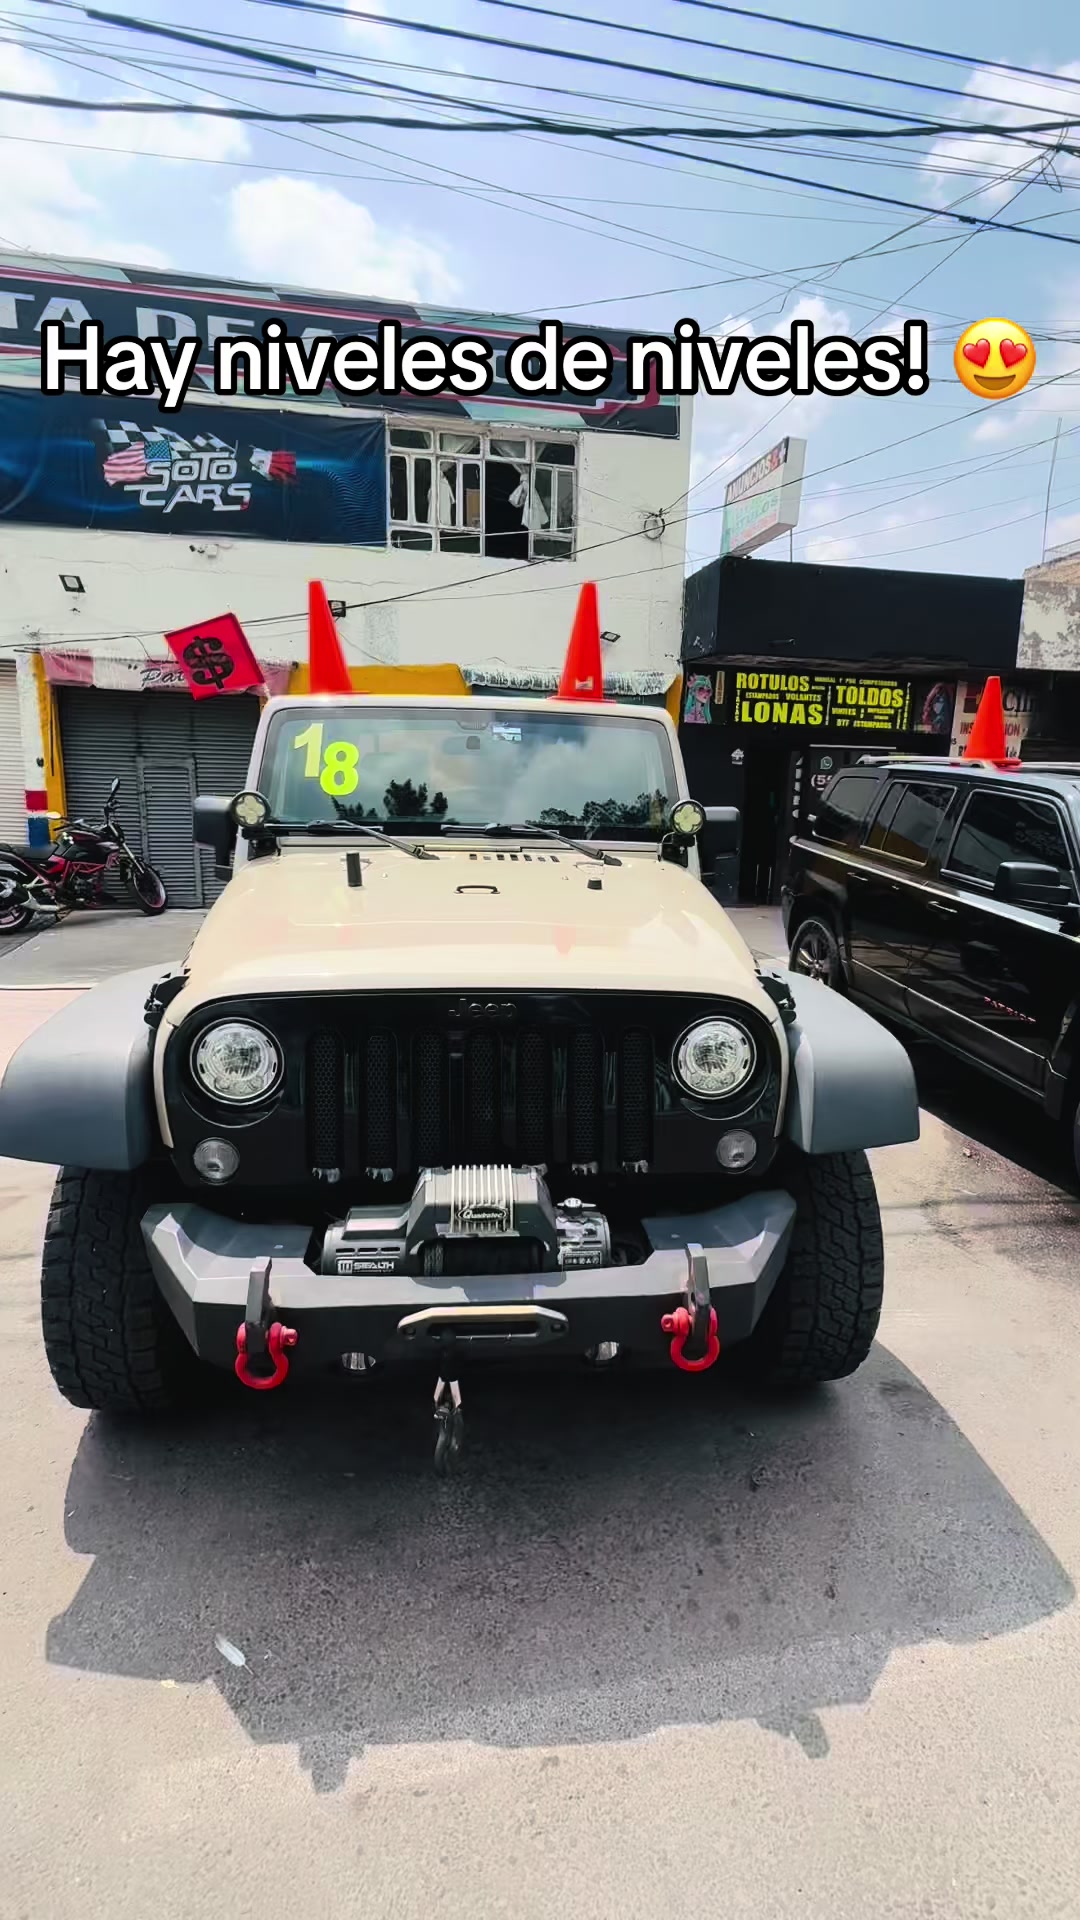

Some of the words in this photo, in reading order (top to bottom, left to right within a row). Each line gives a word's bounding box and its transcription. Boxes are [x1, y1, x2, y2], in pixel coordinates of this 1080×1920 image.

[144, 452, 237, 490] SOTO
[124, 482, 252, 513] CARS
[736, 672, 810, 691] ROTULOS
[785, 693, 822, 702] VOLANTES
[836, 685, 904, 708] TOLDOS
[741, 701, 823, 725] LONAS
[294, 722, 359, 796] 18
[447, 998, 517, 1018] Jeep
[462, 1209, 503, 1219] Quadratec
[353, 1261, 394, 1270] STEALTH
